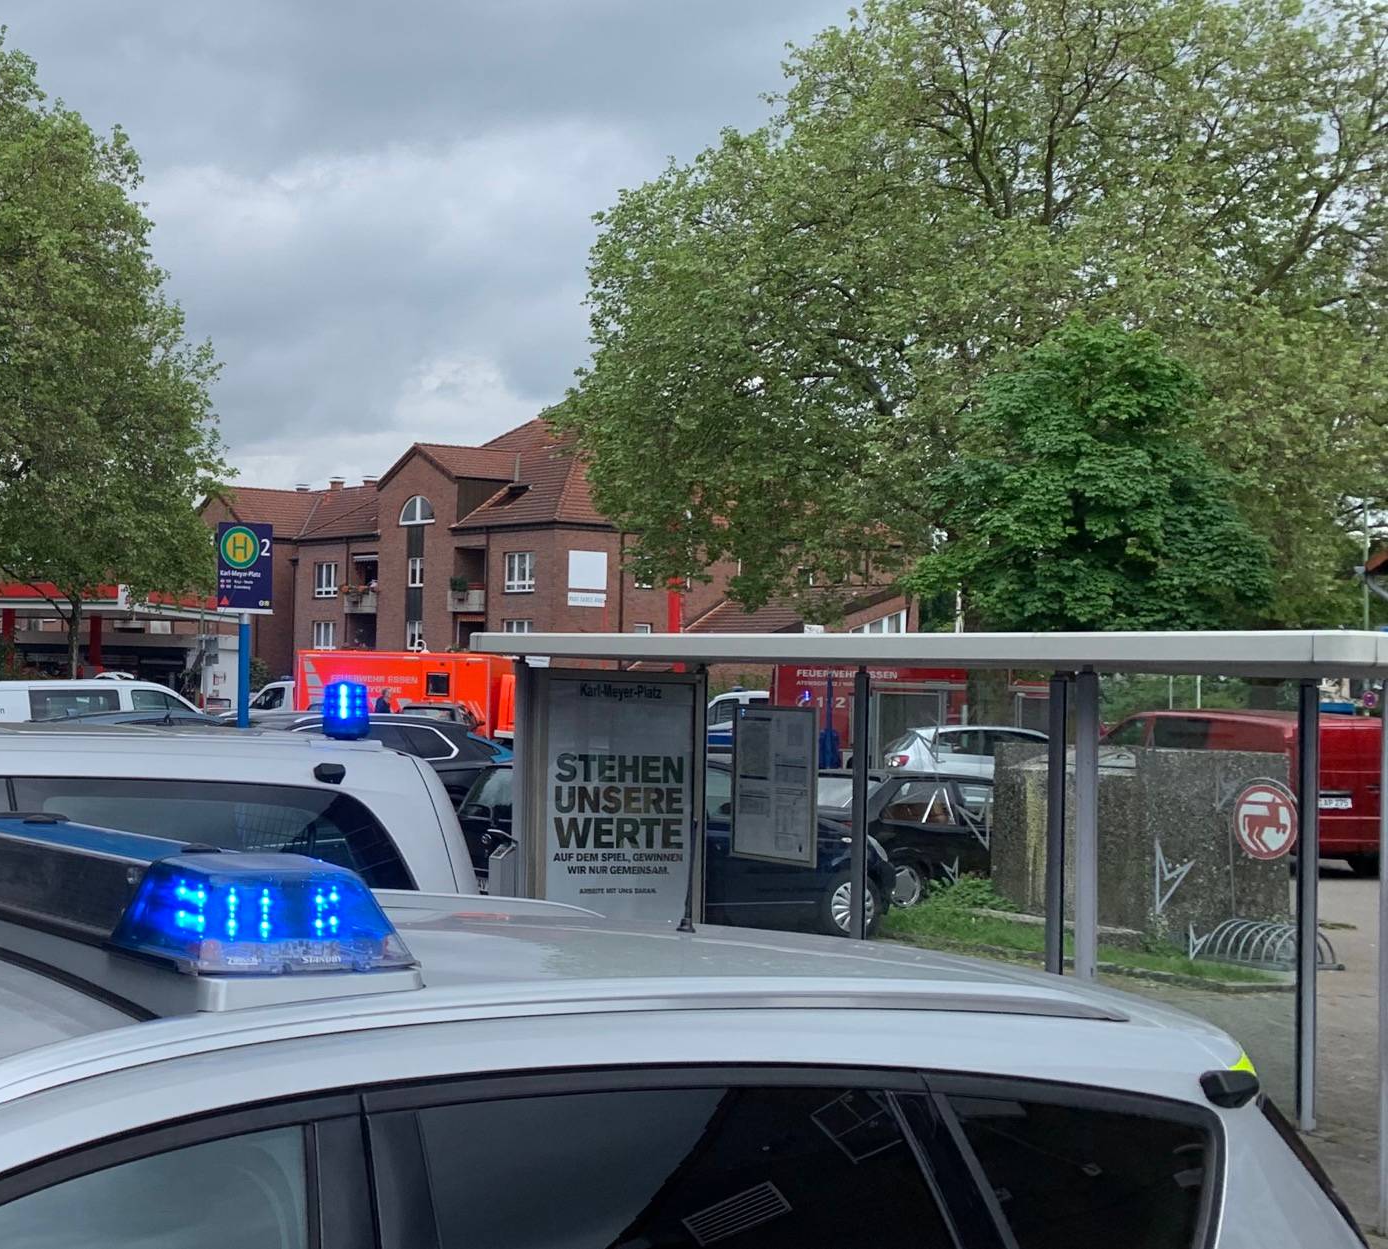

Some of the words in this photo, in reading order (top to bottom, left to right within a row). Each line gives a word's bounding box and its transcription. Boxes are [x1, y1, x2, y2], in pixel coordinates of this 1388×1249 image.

[260, 538, 270, 557] 2
[869, 671, 898, 679] SSEN
[579, 683, 662, 700] Karl-Meyer-Platz
[816, 696, 846, 708] 12
[555, 752, 684, 784] STEHEN
[554, 785, 684, 815] UNSERE
[553, 817, 683, 849] WERTE
[553, 853, 574, 862] AUF
[576, 853, 598, 862] DEM
[601, 853, 631, 863] SPIEL,
[632, 853, 683, 862] GEWINNEN
[567, 866, 586, 875] WIR
[589, 866, 607, 875] NUR
